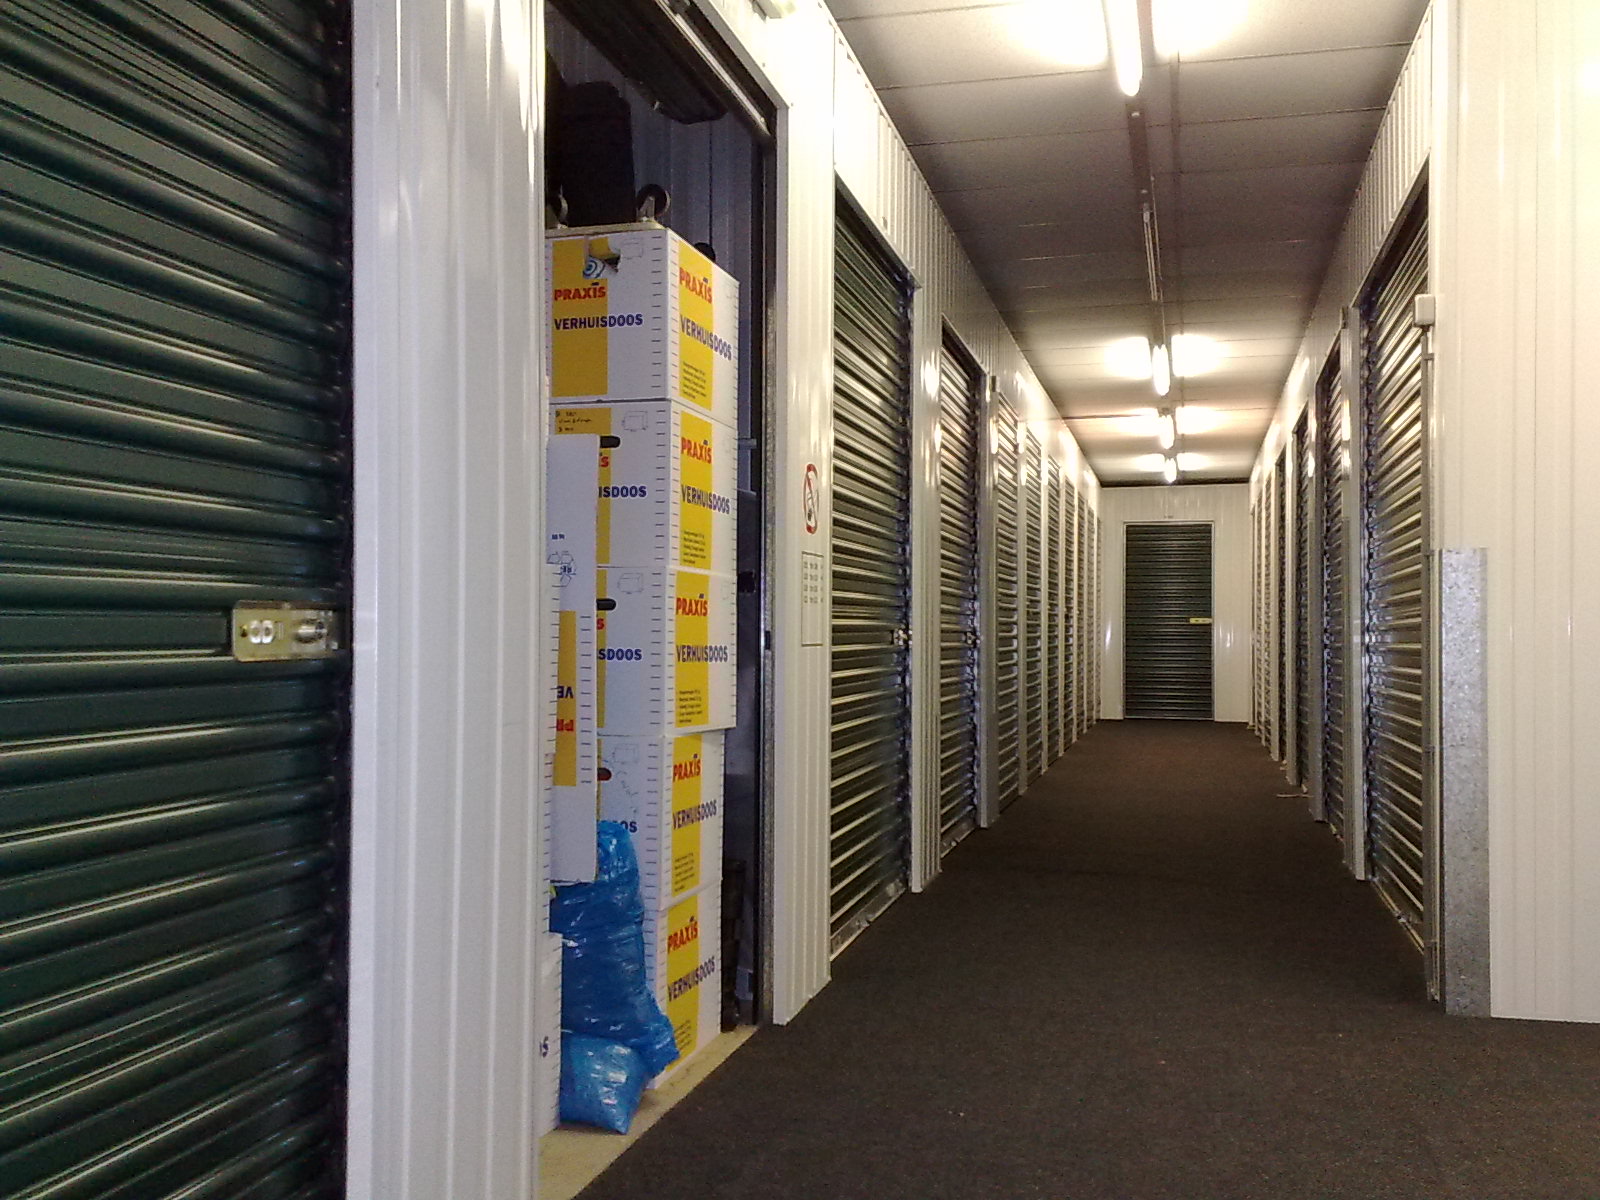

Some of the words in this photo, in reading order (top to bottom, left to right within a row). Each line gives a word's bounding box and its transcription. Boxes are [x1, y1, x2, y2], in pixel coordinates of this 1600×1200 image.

[554, 282, 606, 301] PRAXIS
[679, 267, 713, 304] PRAXIS
[554, 314, 643, 331] VERHUISDOOS
[680, 314, 732, 361] VERHUISDOOS
[681, 437, 712, 464] PRAXIS
[681, 484, 730, 514] VERHUISDOOS
[676, 594, 708, 616] PRAXIS
[676, 645, 728, 662] VERHUISDOOS
[673, 753, 701, 783] PRAXIS
[673, 799, 717, 830] VERHUISDOOS
[668, 916, 698, 954] PRAXIS
[668, 956, 715, 1002] VERHUISDOOS
